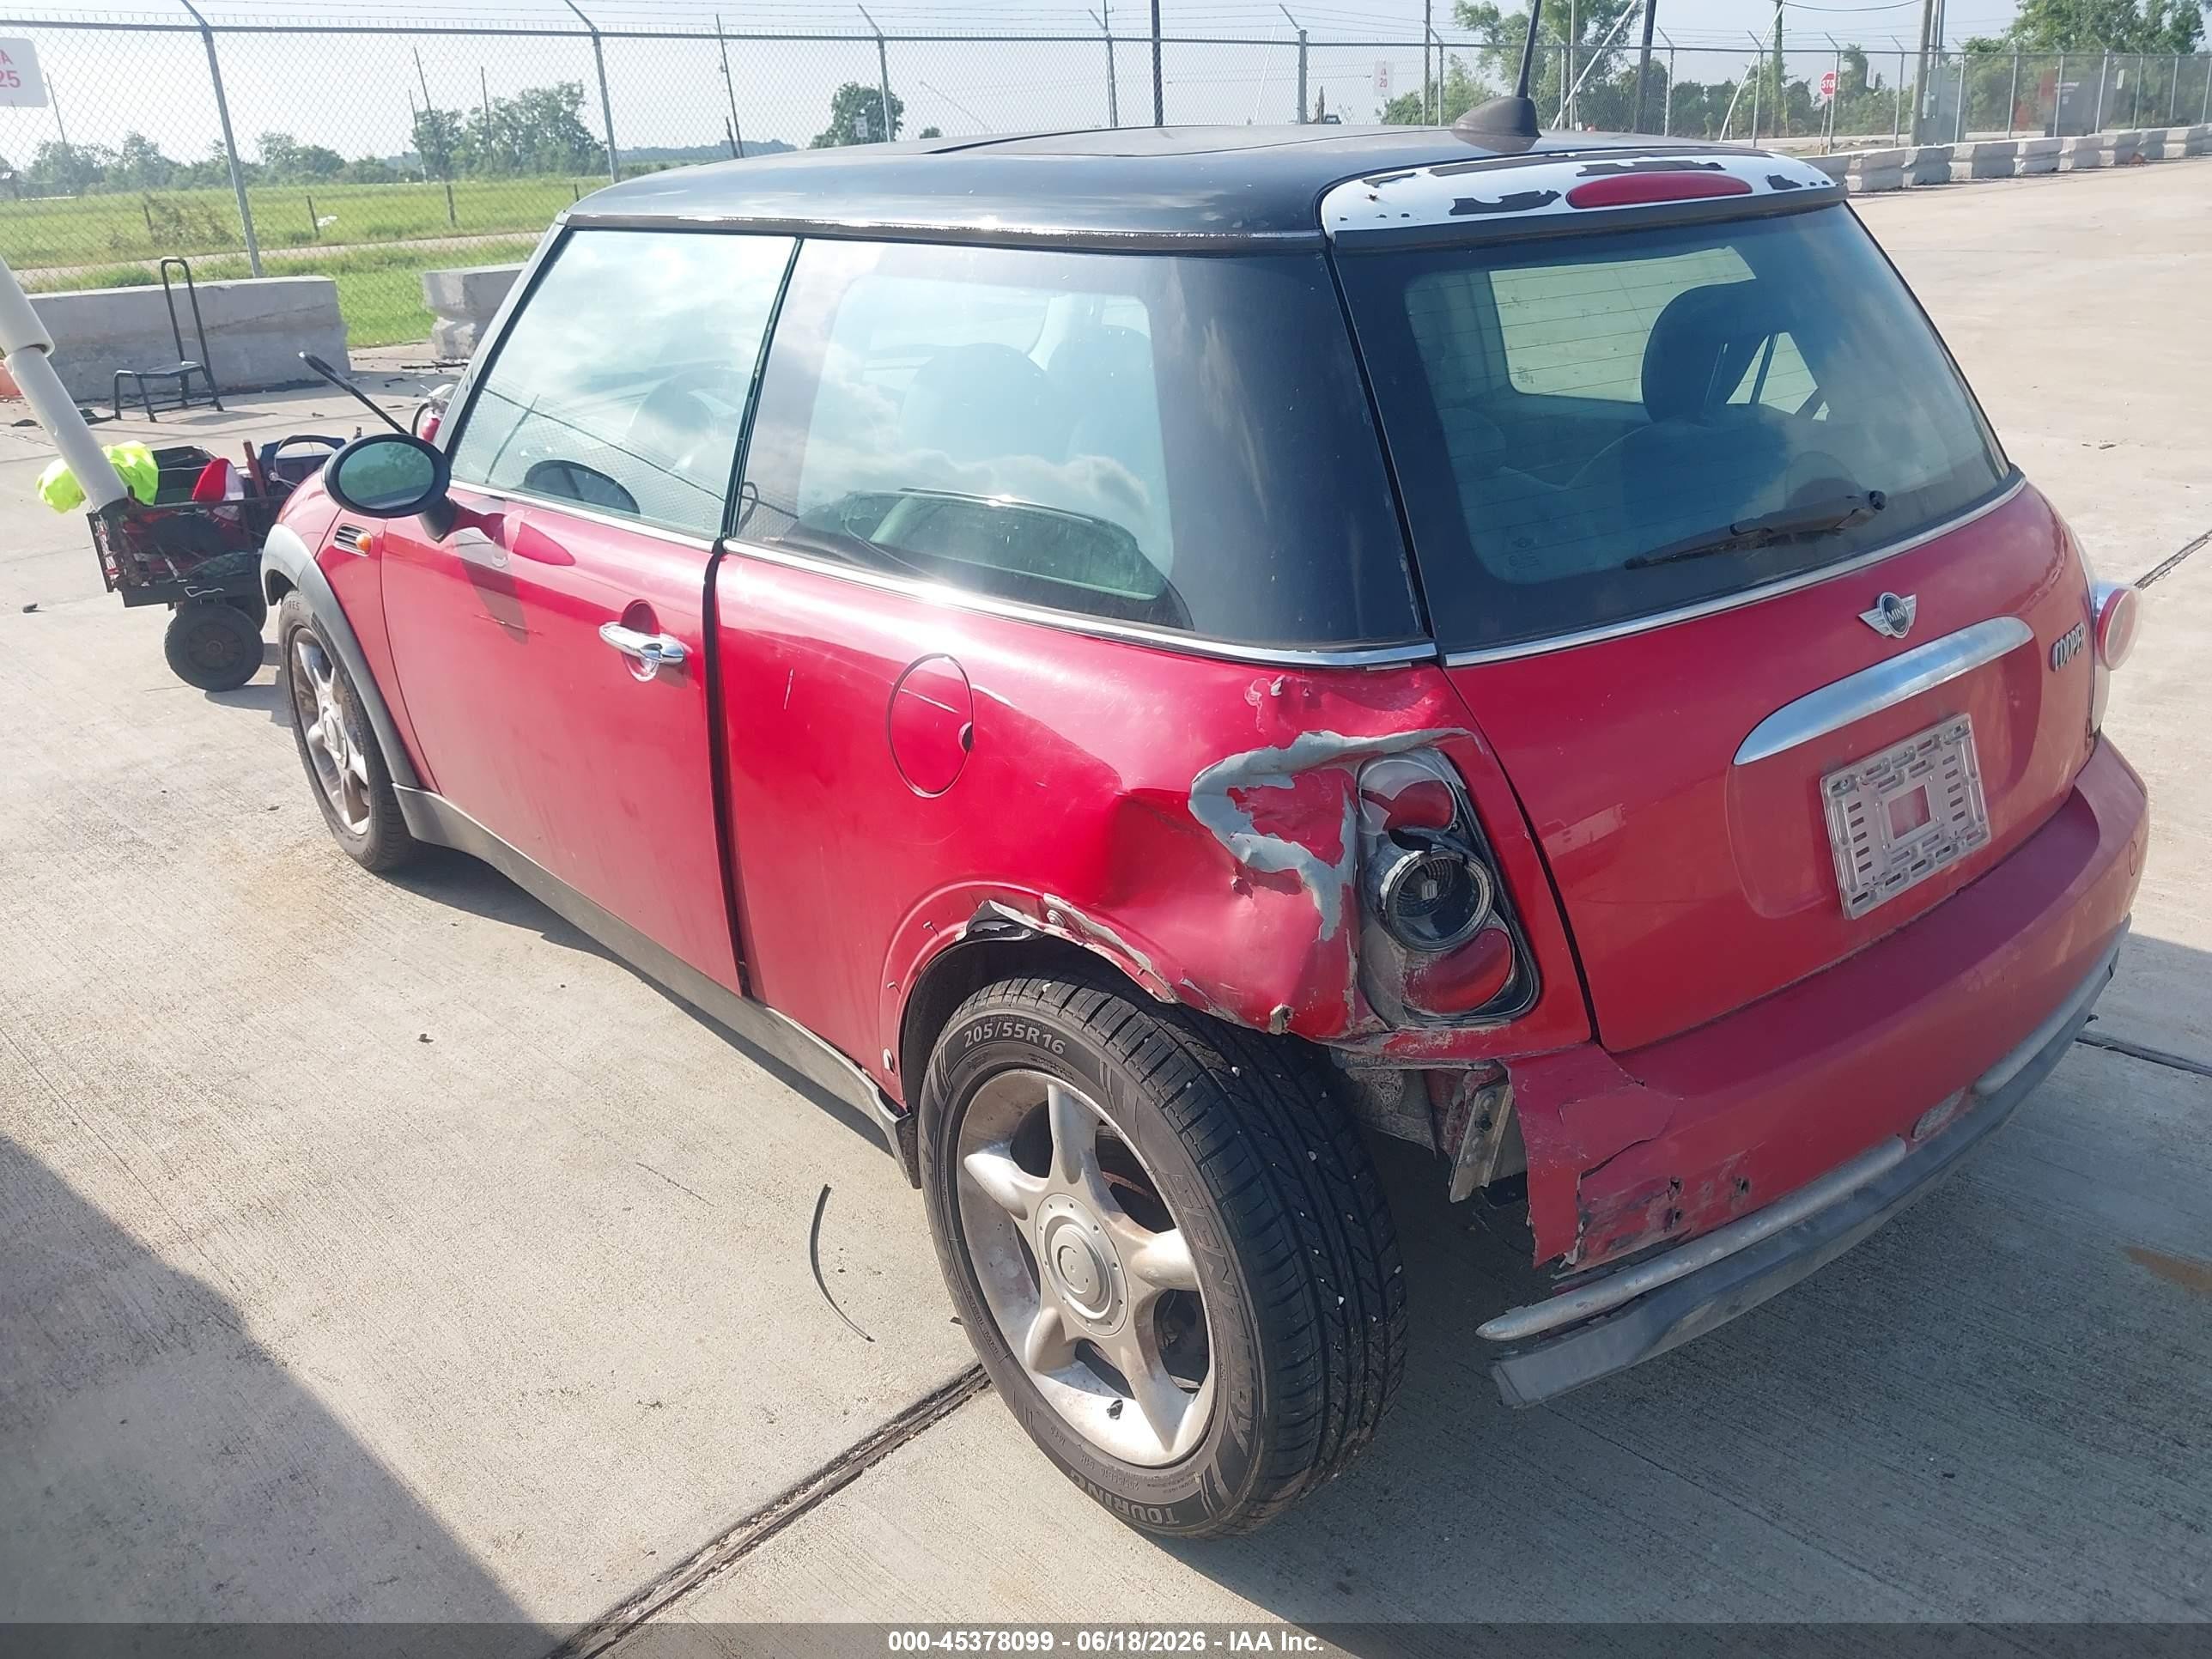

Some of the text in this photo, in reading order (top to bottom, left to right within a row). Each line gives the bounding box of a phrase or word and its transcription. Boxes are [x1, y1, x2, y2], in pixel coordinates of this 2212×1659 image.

[2052, 622, 2086, 672] COOPER
[963, 1021, 1066, 1055] 205/55R16
[1070, 1469, 1180, 1525] TOURING
